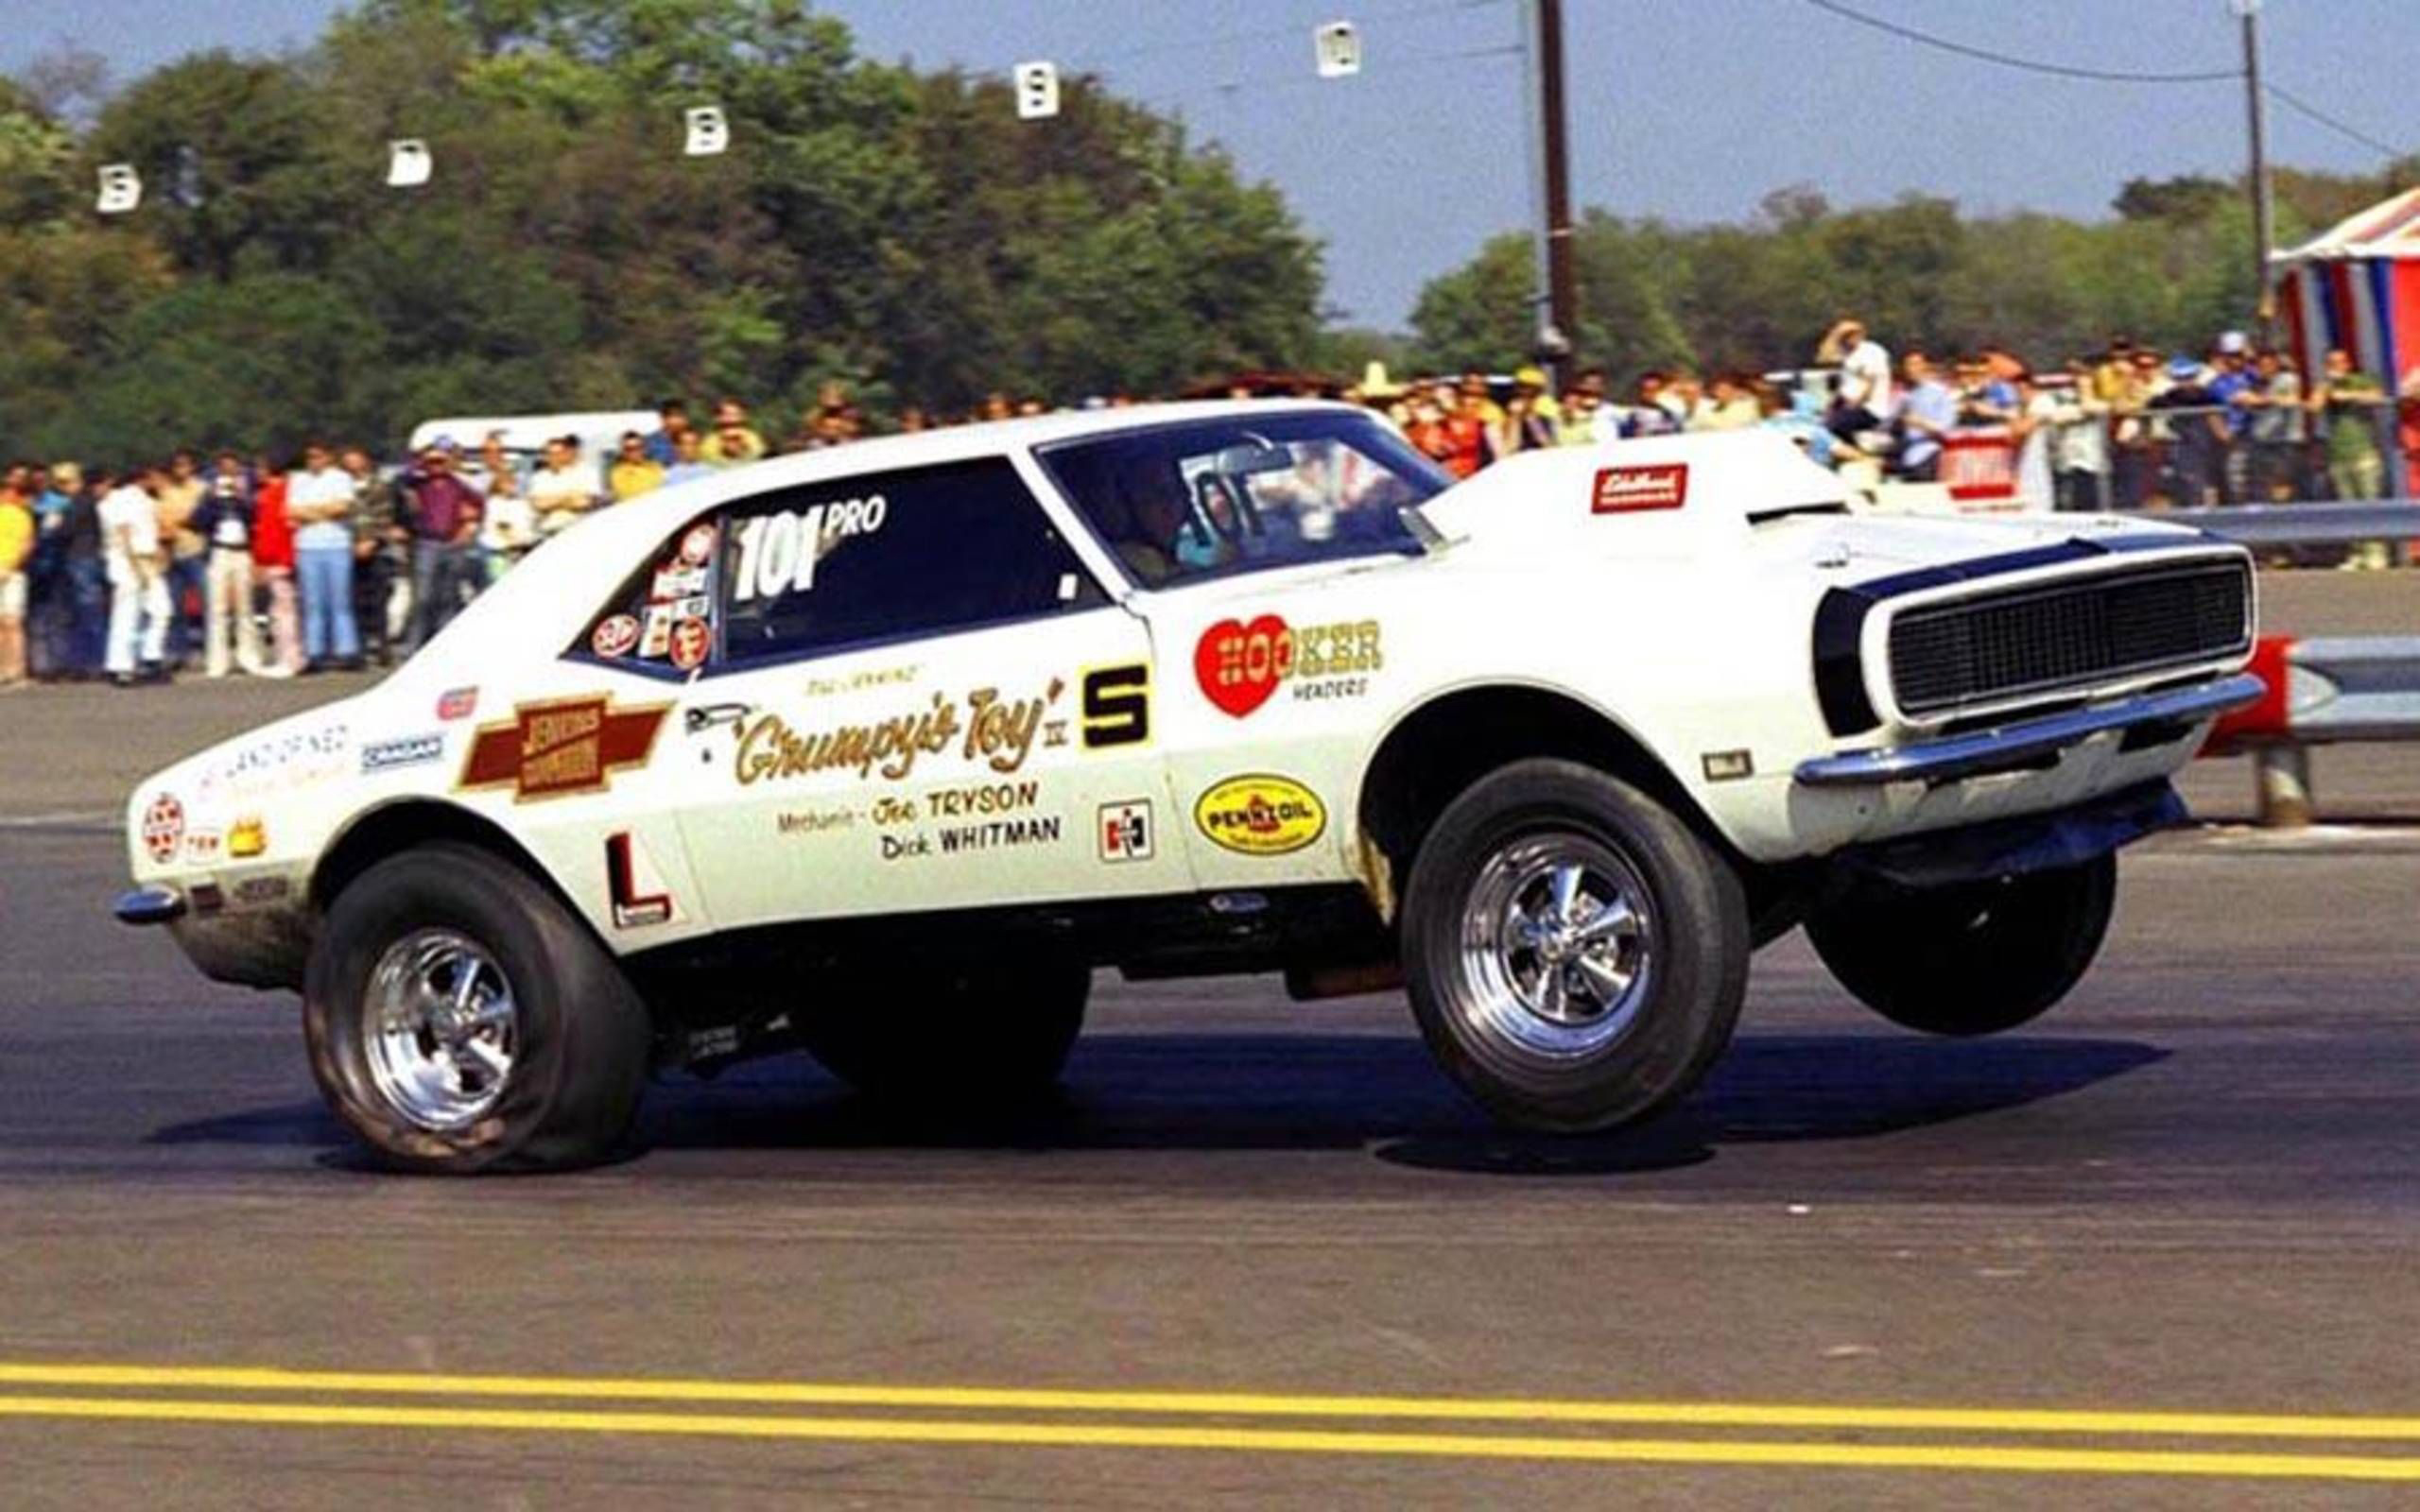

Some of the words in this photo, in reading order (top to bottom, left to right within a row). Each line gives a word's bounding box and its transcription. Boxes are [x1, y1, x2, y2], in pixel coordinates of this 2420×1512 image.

[735, 504, 824, 602] 101
[823, 495, 886, 538] PRO
[1217, 620, 1383, 686] HOOKER
[1083, 663, 1149, 748] S
[1293, 678, 1369, 701] HEADERS
[927, 781, 1038, 818] TRYSON
[1208, 800, 1314, 829] PENNZOIL
[881, 833, 931, 860] Dick
[939, 816, 1061, 854] WHITMAN
